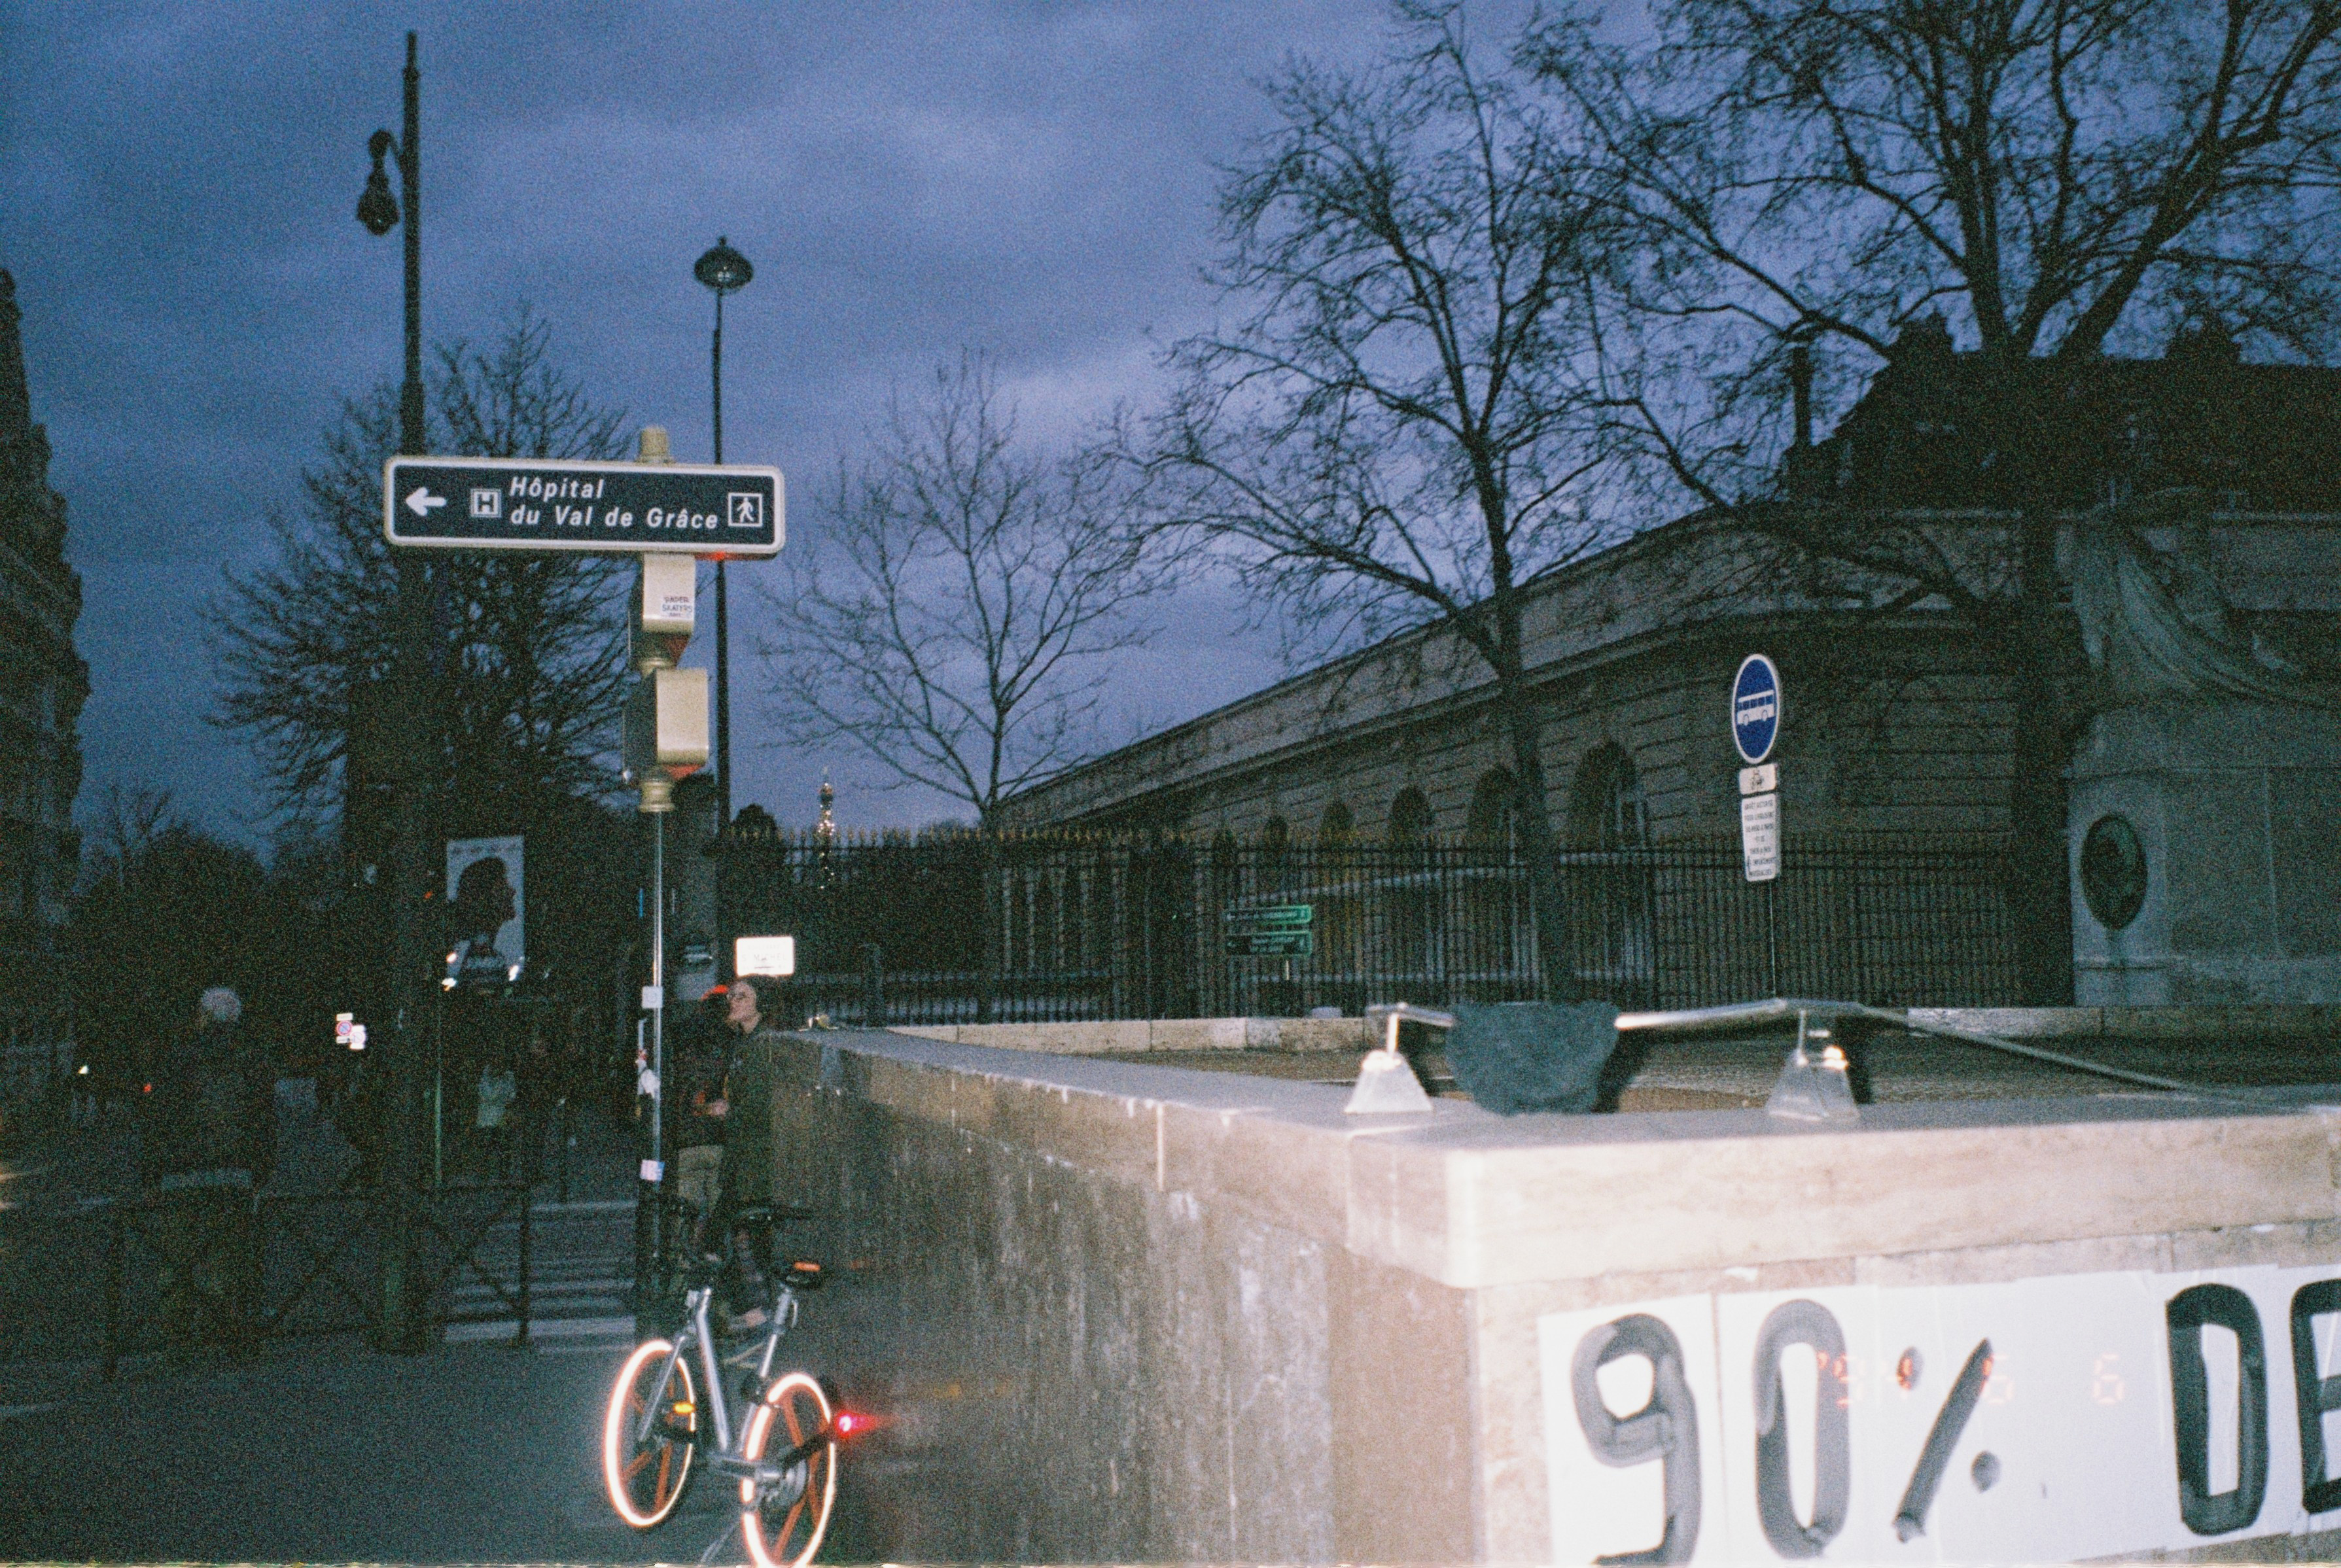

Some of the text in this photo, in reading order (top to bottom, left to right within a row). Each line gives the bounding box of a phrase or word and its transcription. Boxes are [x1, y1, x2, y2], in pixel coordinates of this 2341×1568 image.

[509, 476, 604, 502] Hôpital
[477, 493, 495, 512] H
[510, 504, 718, 529] du Val de Grâce
